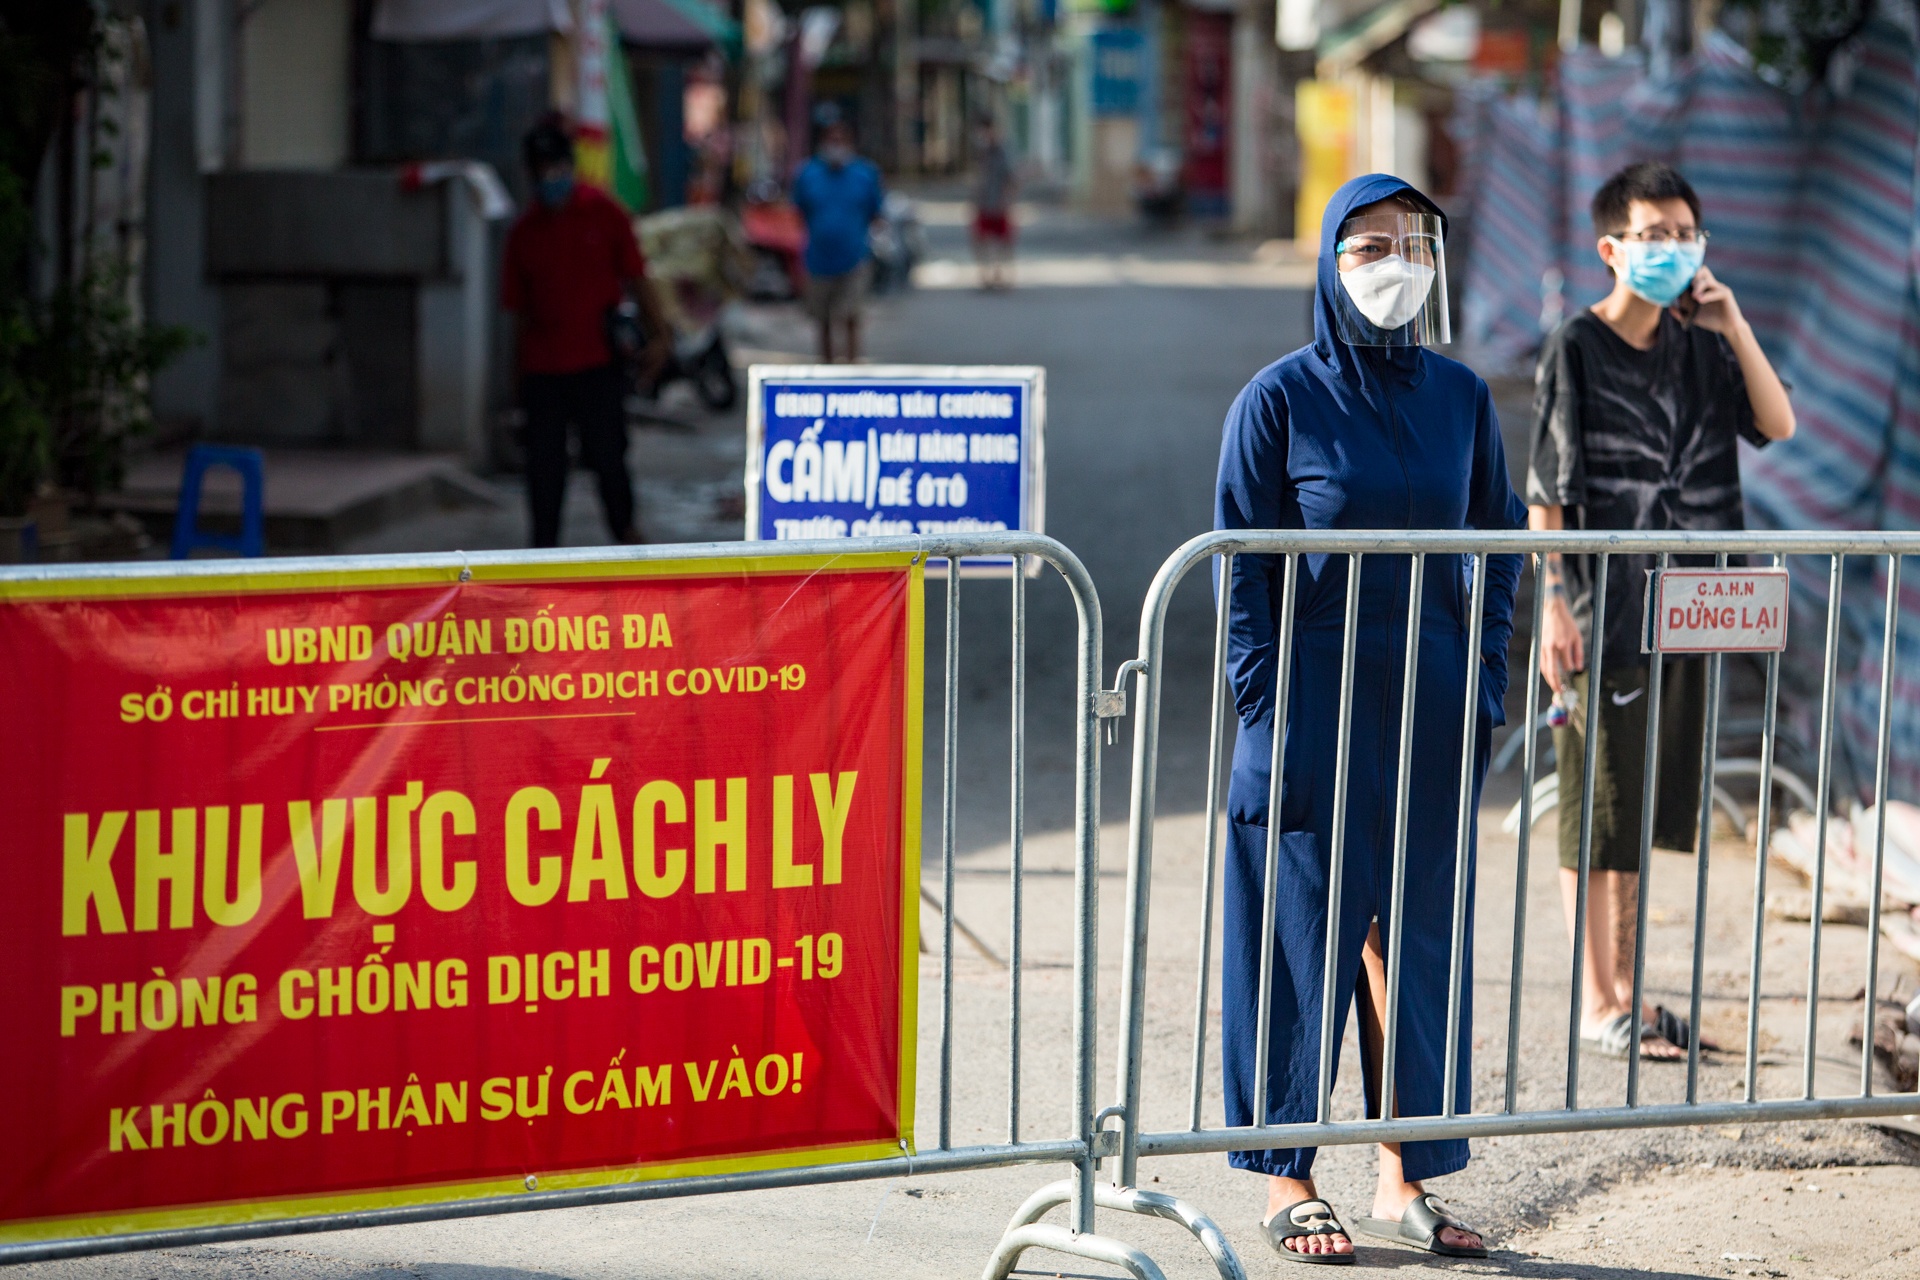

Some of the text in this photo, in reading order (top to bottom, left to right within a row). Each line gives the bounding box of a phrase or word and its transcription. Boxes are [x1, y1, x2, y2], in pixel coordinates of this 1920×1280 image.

[766, 418, 867, 503] CẤM
[880, 429, 917, 463] BÁN
[918, 429, 968, 463] HÀNG
[1669, 599, 1778, 635] DỪNG LẠI
[1697, 581, 1754, 596] C.A.H.N
[266, 603, 673, 666] UBND QUẬN ĐỐNG ĐA
[120, 663, 806, 723] SỞ CHỈ HUY PHÒNG CHỐNG DỊCH COVID-19
[62, 757, 859, 944] KHU VỰC CÁCH LY
[61, 932, 843, 1037] PHÒNG CHỐNG DỊCH COVID-19
[109, 1044, 804, 1152] KHÔNG PHẬN SỰ CẤM VÀO!
